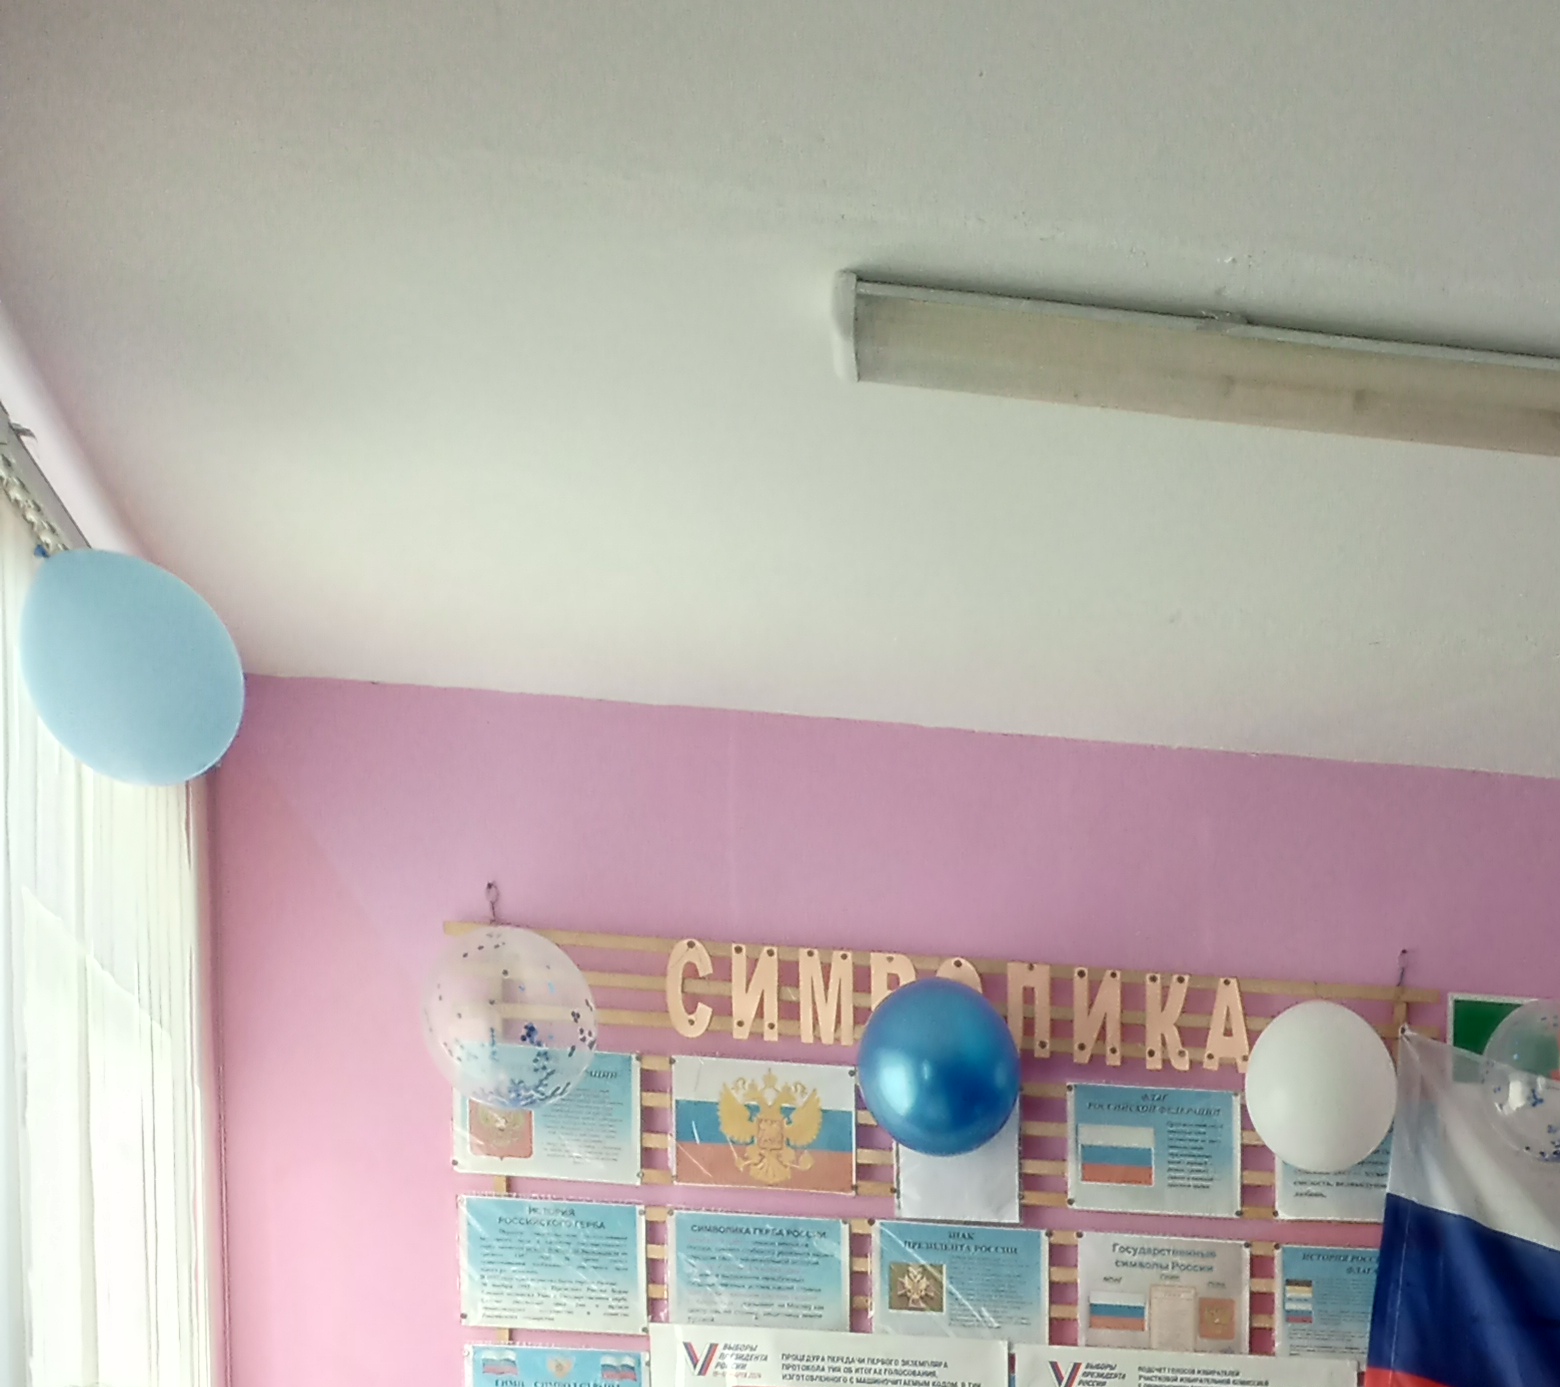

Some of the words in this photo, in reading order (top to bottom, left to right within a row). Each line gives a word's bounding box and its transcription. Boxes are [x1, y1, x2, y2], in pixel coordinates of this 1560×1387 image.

[1170, 1261, 1214, 1272] России
[723, 1343, 758, 1352] ВЫБОРЫ
[781, 1353, 825, 1363] ПРОЦЕДУРА
[826, 1355, 866, 1365] ПЕРЕДАЧИ
[867, 1357, 899, 1367] ПЕРВОГО
[901, 1359, 949, 1369] ЭКЗЕМПЛЯРА
[781, 1363, 825, 1373] ПРОТОКОЛА
[781, 1373, 848, 1384] ИЗГОТОВЛЕННОГО
